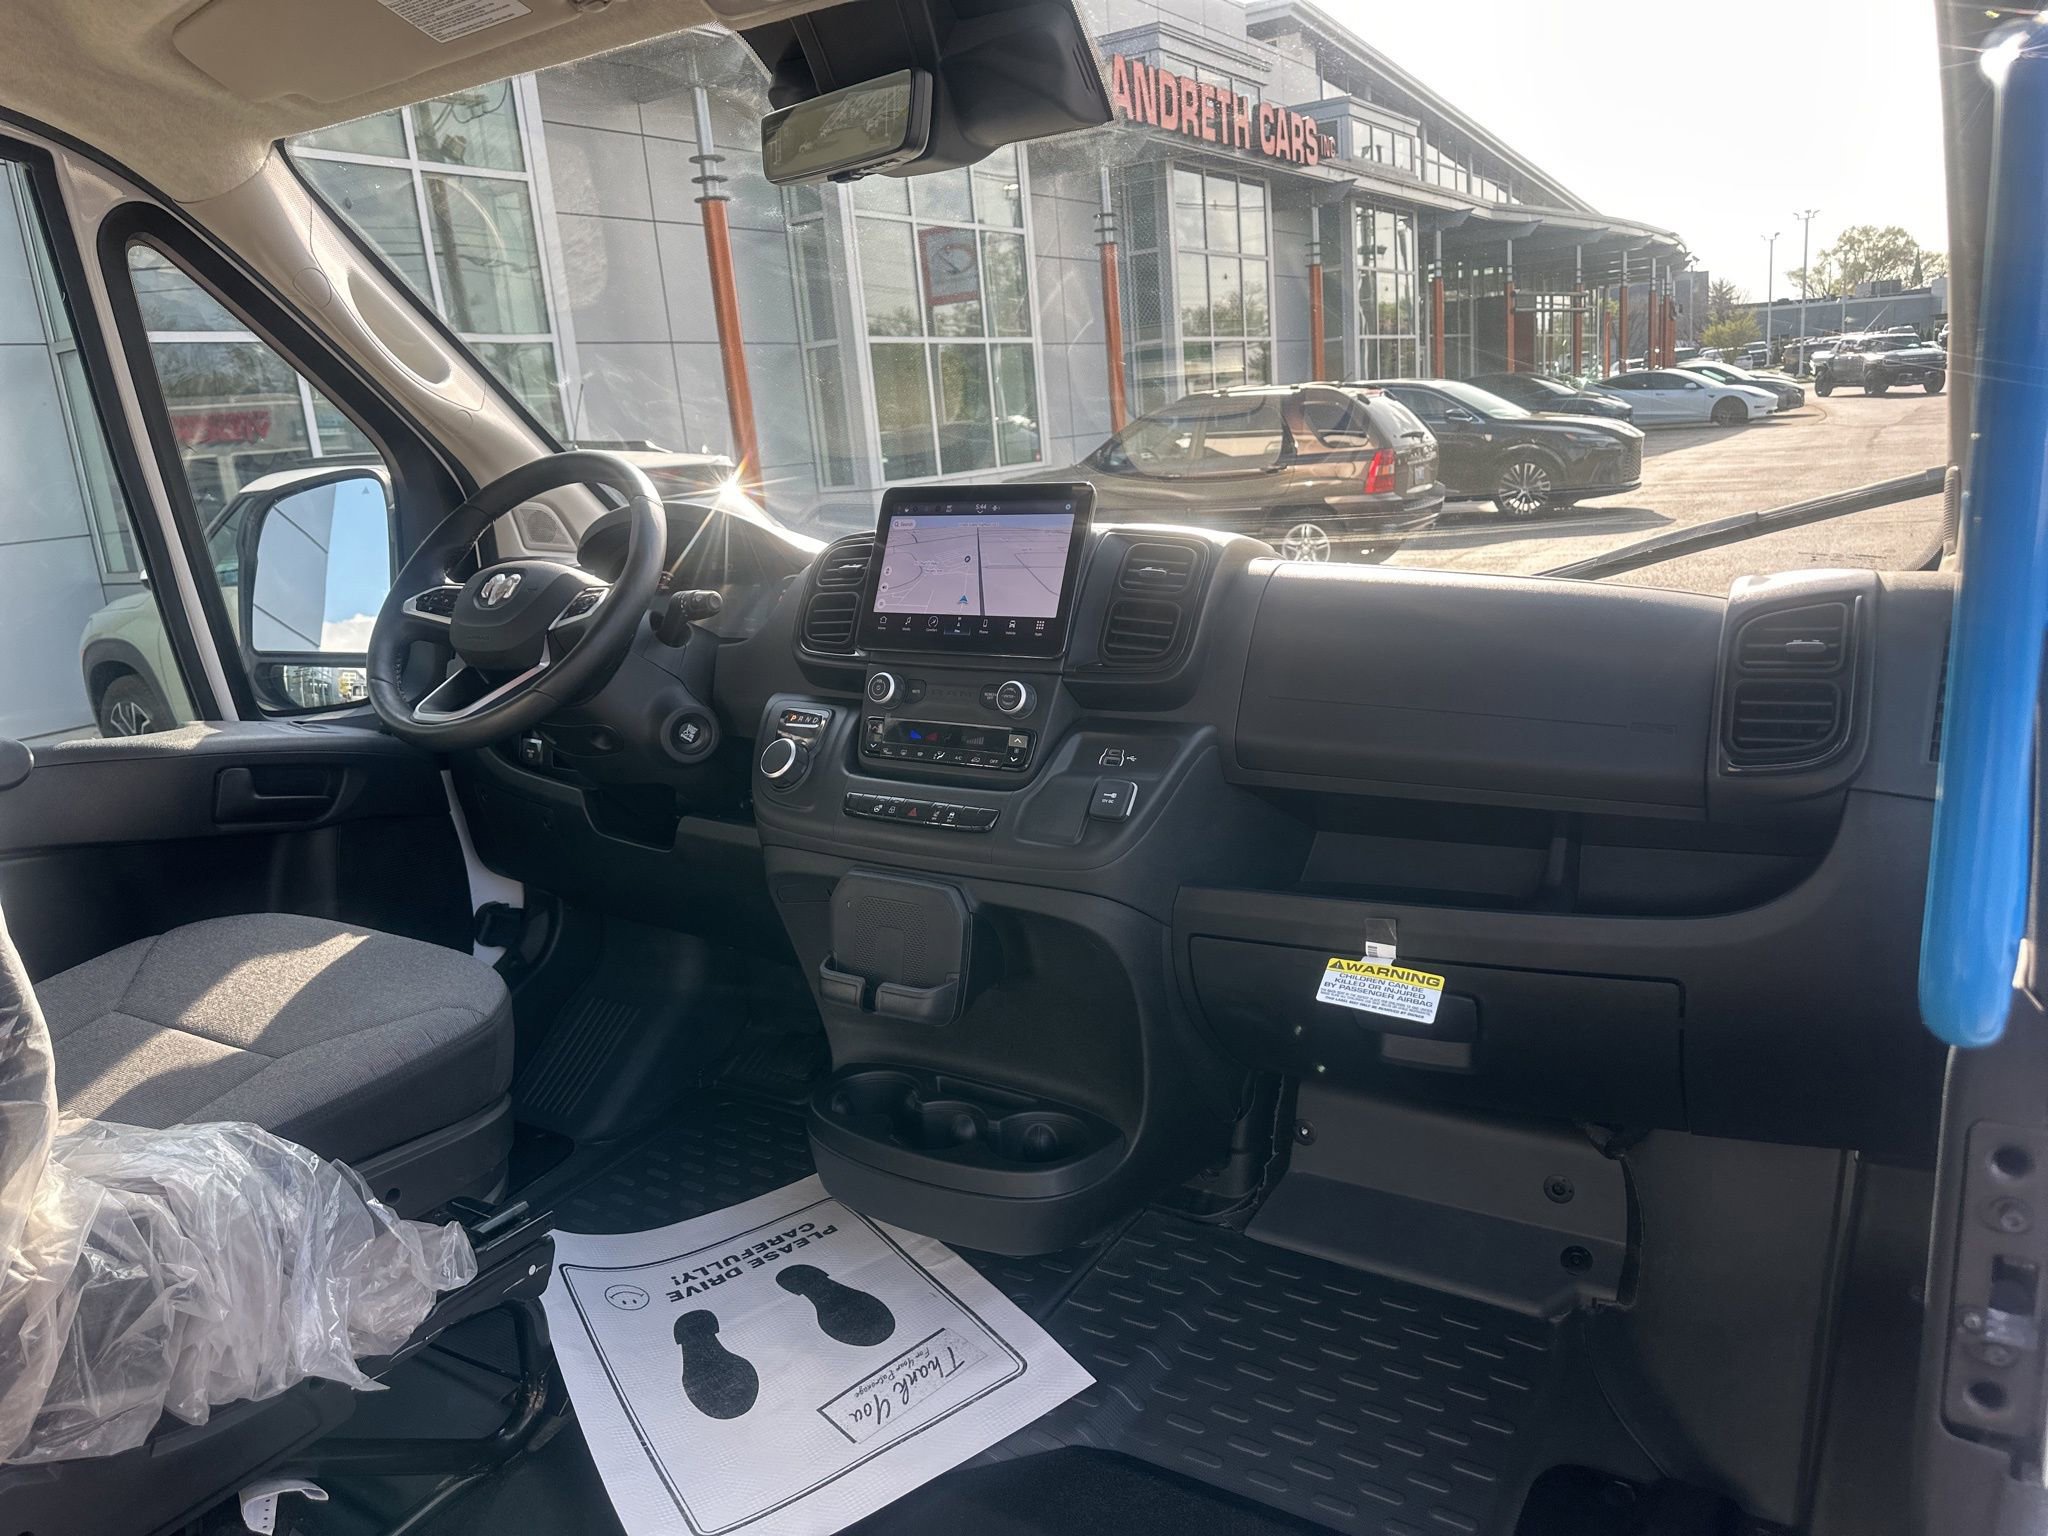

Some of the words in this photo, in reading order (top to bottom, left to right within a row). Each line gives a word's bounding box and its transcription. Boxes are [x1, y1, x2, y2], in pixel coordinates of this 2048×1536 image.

[1258, 101, 1319, 166] CARS
[1334, 977, 1366, 988] KILLED
[1384, 986, 1426, 1000] INJURED
[1339, 972, 1386, 985] CHILDREN
[1388, 981, 1409, 990] CAN
[1346, 962, 1441, 987] WARNING
[1339, 984, 1395, 1000] PASSENGER
[1396, 995, 1433, 1007] AIRBAG
[670, 1222, 816, 1286] CAREFULLY!
[747, 1224, 839, 1269] PLEASE
[665, 1266, 744, 1303] DRIVE
[895, 1358, 915, 1372] Your
[915, 1347, 930, 1359] For
[854, 1369, 896, 1398] Patronage
[893, 1346, 966, 1405] Thank
[848, 1394, 892, 1425] You
